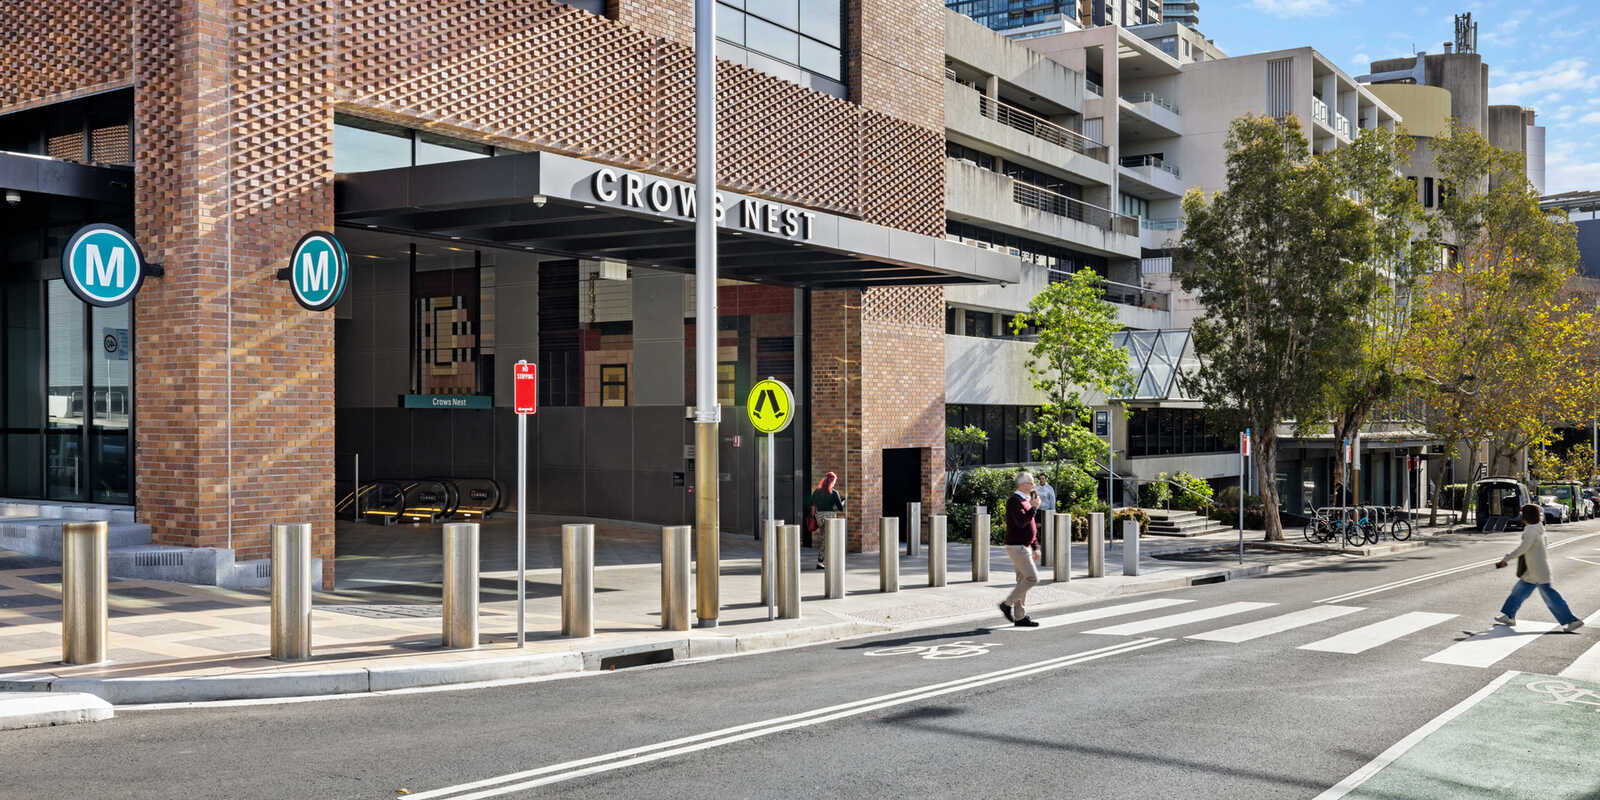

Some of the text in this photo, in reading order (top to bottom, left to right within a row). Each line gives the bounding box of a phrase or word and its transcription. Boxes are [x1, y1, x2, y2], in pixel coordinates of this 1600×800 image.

[743, 199, 816, 240] NEST
[85, 243, 125, 288] M
[302, 251, 329, 292] M
[432, 397, 466, 406] Crows Nest
